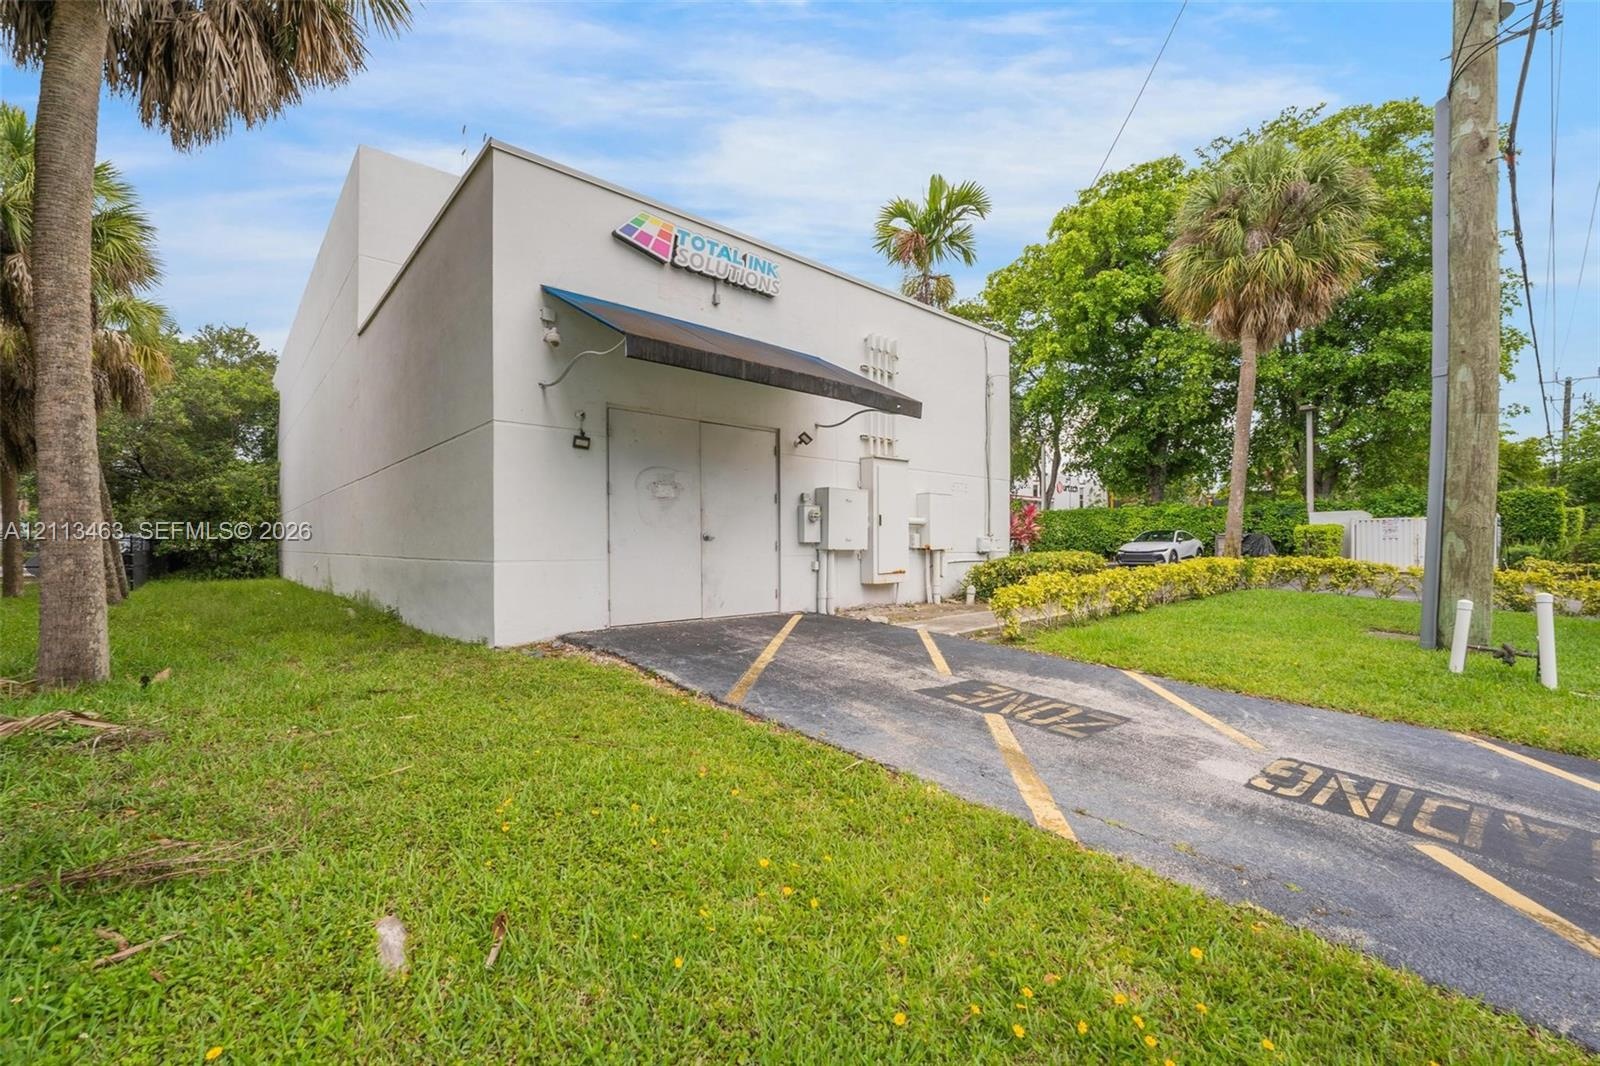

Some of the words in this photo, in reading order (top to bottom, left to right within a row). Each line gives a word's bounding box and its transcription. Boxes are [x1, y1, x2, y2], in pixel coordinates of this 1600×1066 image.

[676, 228, 744, 267] TOTAL
[748, 254, 780, 279] INK
[676, 248, 781, 295] SOLUTIONS
[945, 684, 1119, 739] ZONE
[1249, 758, 1600, 881] ADING
